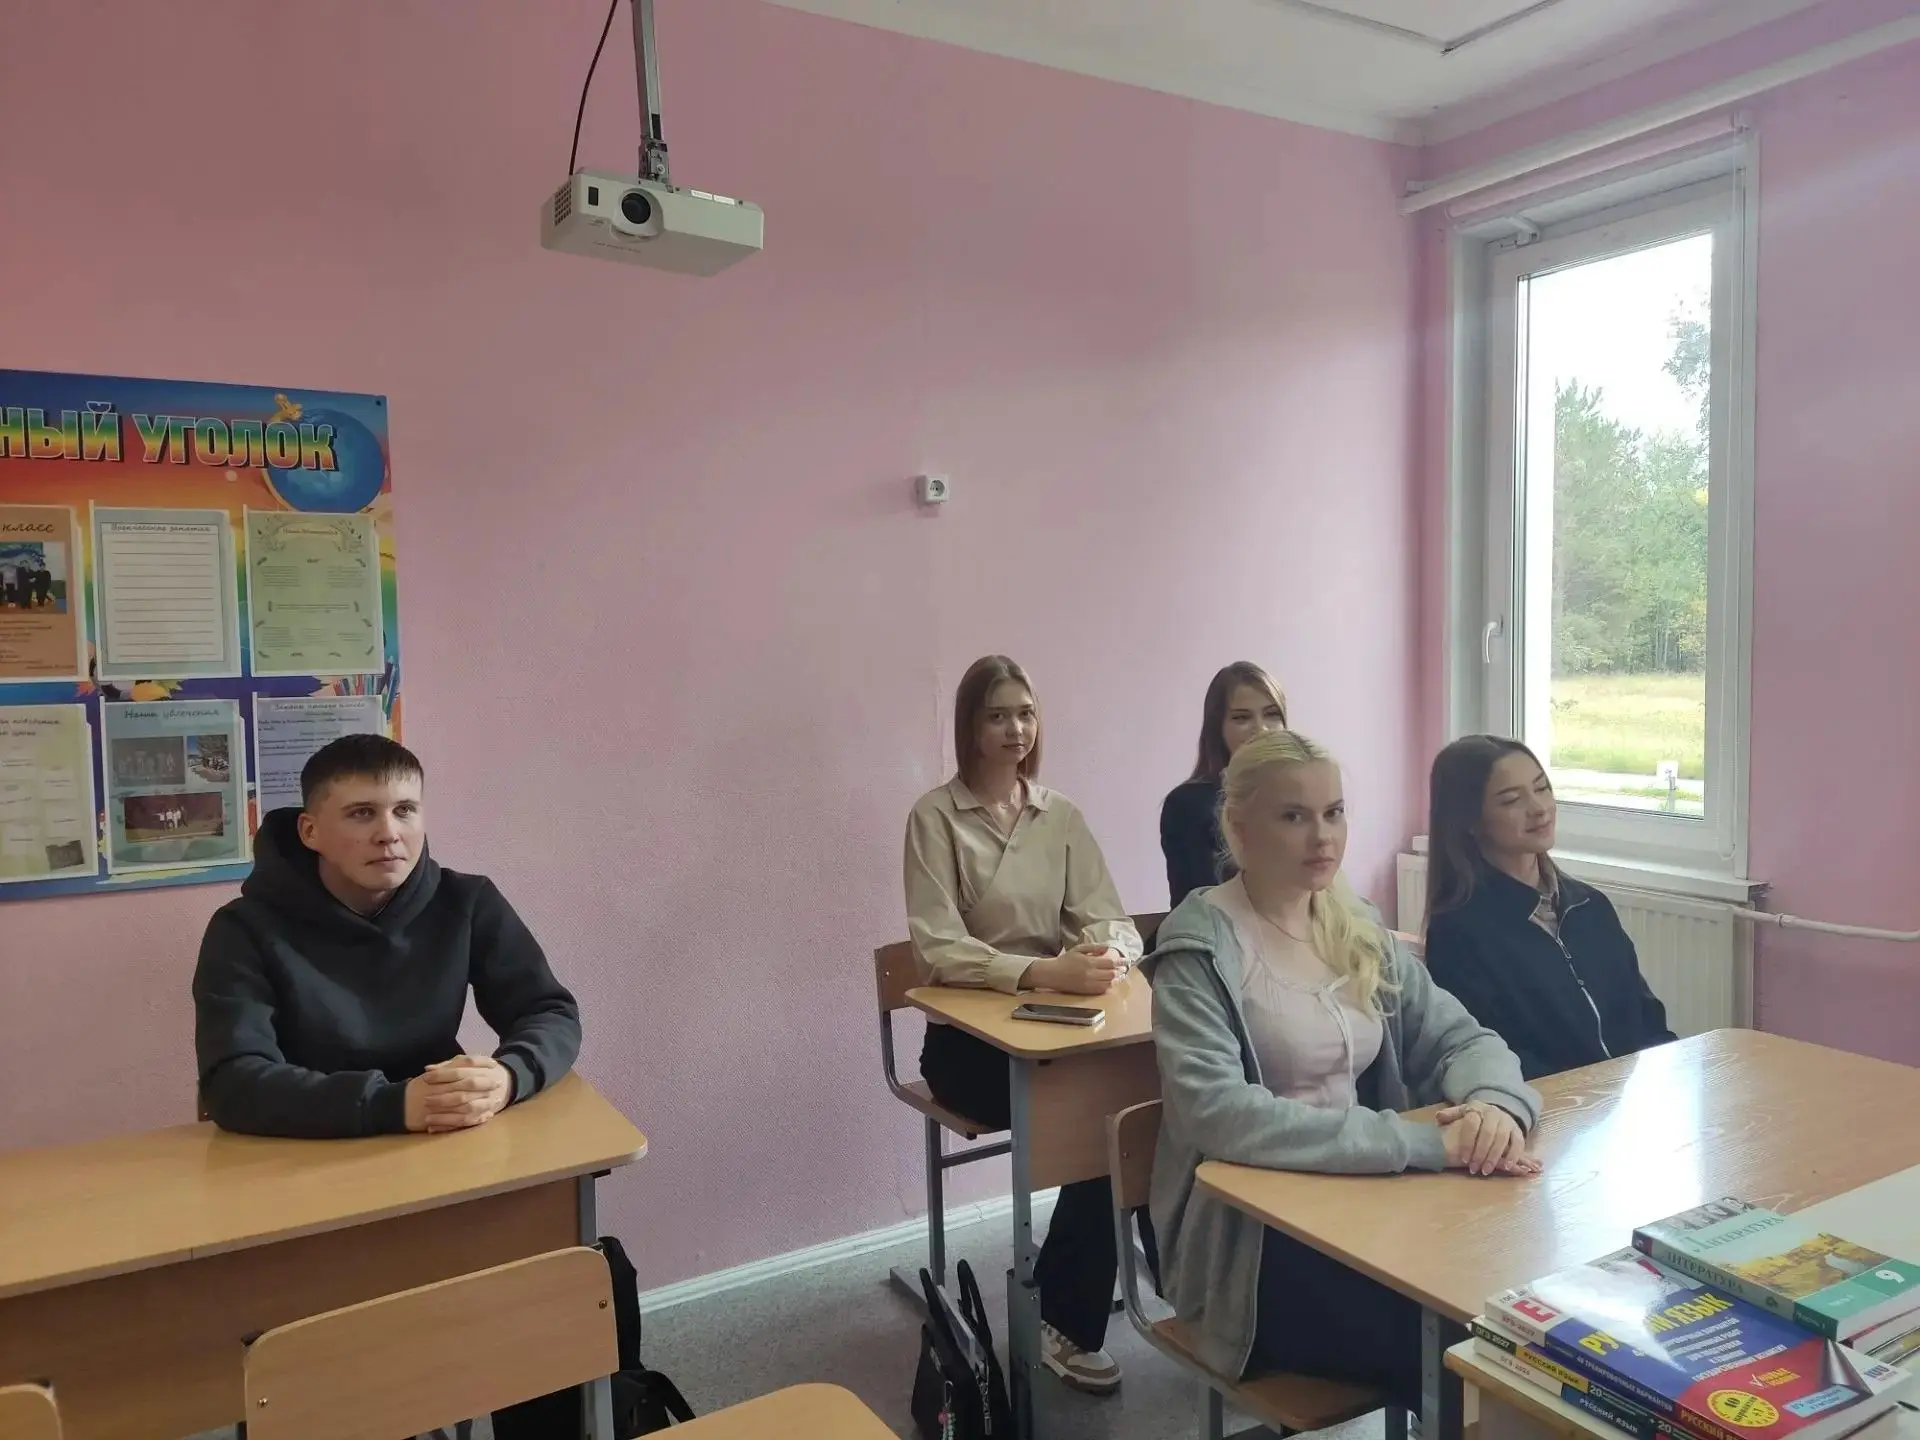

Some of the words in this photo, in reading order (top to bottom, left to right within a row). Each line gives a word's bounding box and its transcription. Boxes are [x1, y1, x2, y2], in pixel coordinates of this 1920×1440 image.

[132, 413, 337, 470] УГОЛОК
[2, 523, 55, 533] класс
[1875, 1269, 1905, 1284] 9
[1663, 1292, 1735, 1325] ЯЗЫК
[1523, 1351, 1558, 1375] РУССКИЙ
[1590, 1385, 1602, 1397] 20
[1579, 1397, 1614, 1421] РУССКИЙ
[1615, 1417, 1639, 1434] ЯЗЫК
[1657, 1421, 1673, 1433] 20
